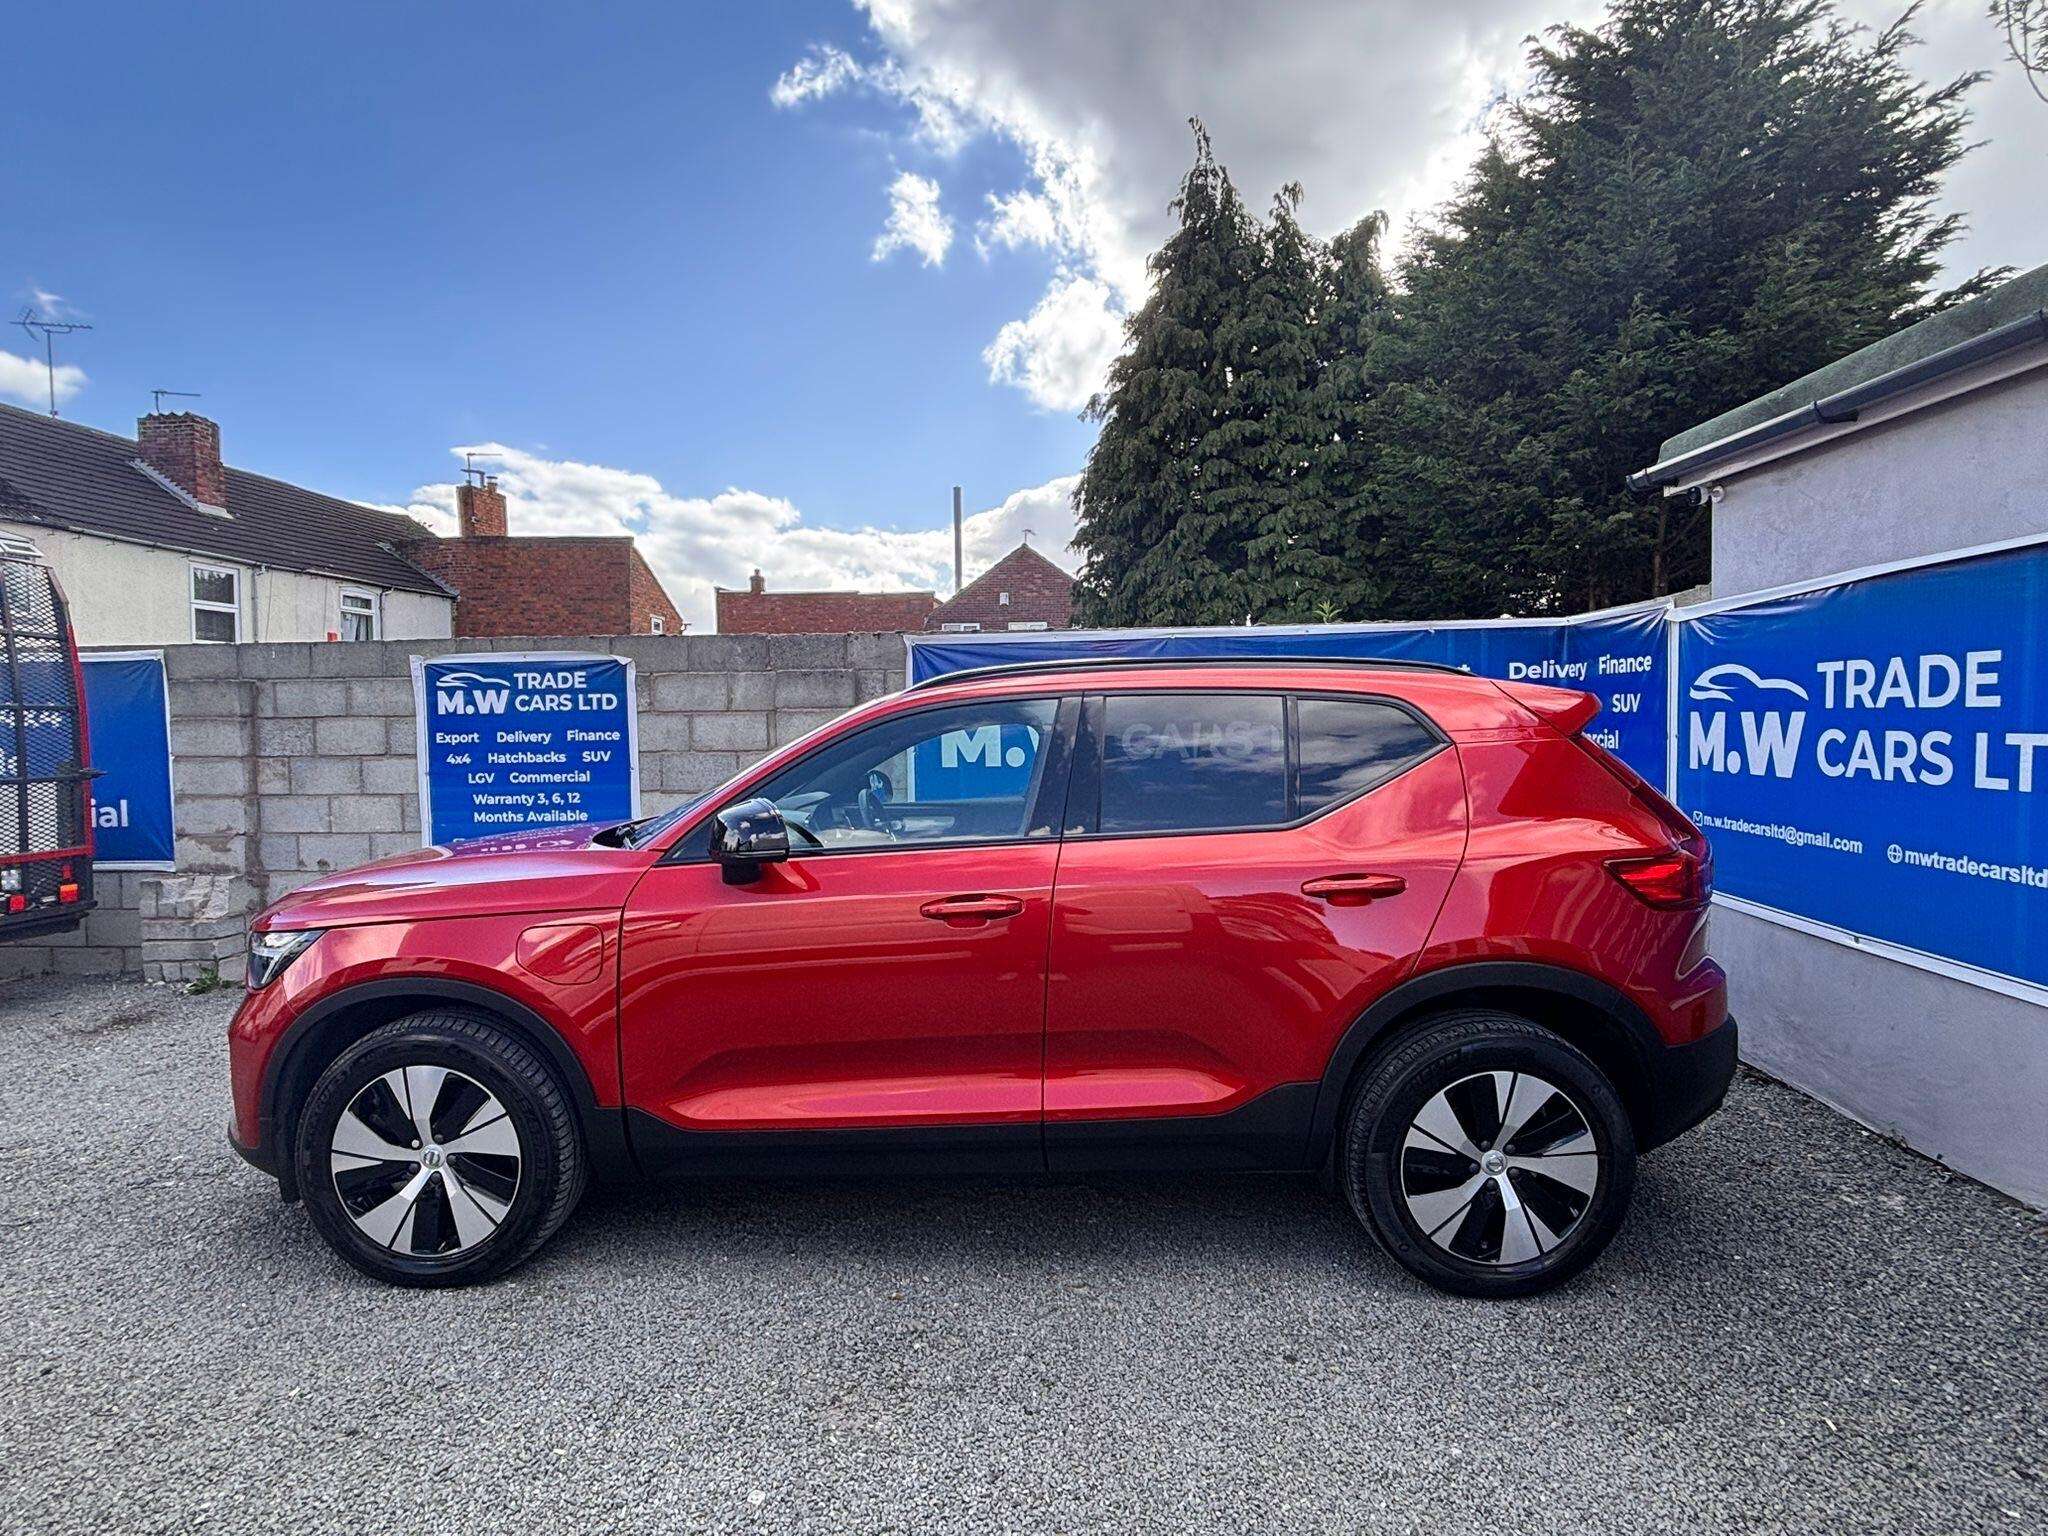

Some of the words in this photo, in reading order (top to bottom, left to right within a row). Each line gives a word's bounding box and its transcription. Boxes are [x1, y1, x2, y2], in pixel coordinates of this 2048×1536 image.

[1509, 659, 1587, 682] Delivery
[1598, 653, 1652, 675] Finance
[513, 671, 587, 690] TRADE
[1816, 649, 2002, 710] TRADE
[437, 689, 510, 715] M.W
[515, 694, 574, 712] CARS
[578, 693, 618, 711] LTD
[1611, 693, 1641, 714] SUV
[436, 731, 480, 745] Export
[496, 731, 552, 745] Delivery
[566, 729, 621, 742] Finance
[941, 724, 1039, 768] M.
[1689, 711, 1807, 779] M.W
[446, 753, 472, 765] 4x4
[487, 751, 567, 764] Hatchbacks
[582, 750, 612, 763] SUV
[1816, 728, 1954, 786] CARS
[1974, 731, 2048, 793] LT
[468, 772, 496, 785] LGV
[509, 770, 591, 784] Commercial
[472, 793, 535, 807] Warranty
[537, 793, 550, 806] 3,
[552, 793, 564, 806] 6,
[566, 792, 581, 804] 12
[473, 811, 524, 823] Months
[526, 809, 588, 823] Available
[1703, 813, 1863, 854] m.w.tradecarsltd@gmail.com
